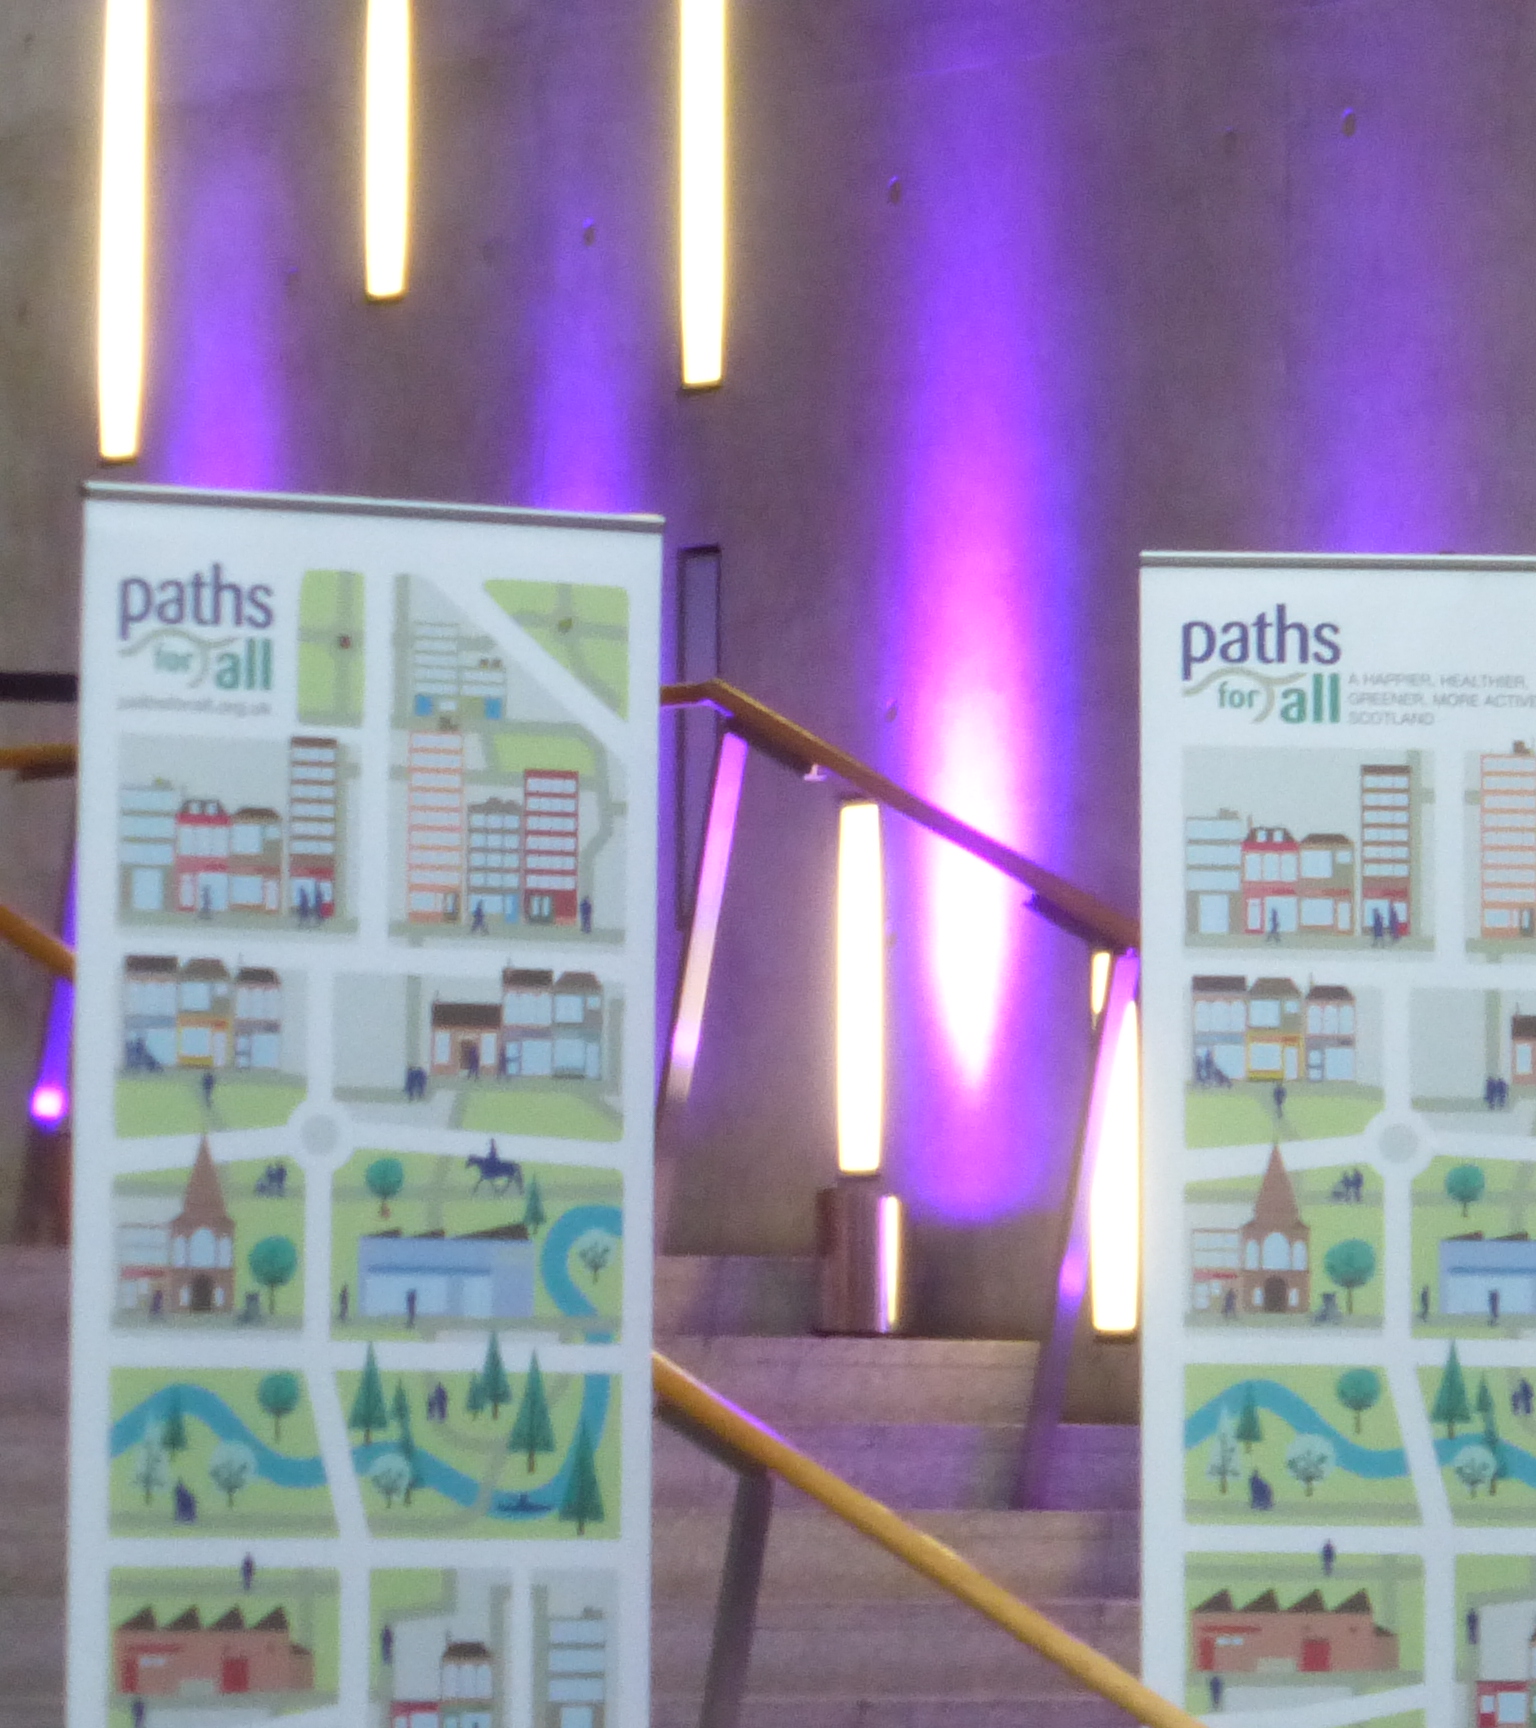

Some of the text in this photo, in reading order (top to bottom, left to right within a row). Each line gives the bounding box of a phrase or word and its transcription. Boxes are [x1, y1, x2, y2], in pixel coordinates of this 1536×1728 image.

[119, 561, 274, 641] paths
[215, 637, 272, 690] all
[1181, 603, 1342, 681] paths
[1218, 673, 1341, 725] for all
[1348, 673, 1358, 685] A
[1433, 693, 1479, 707] MORE
[1350, 711, 1435, 726] SCOTLAND
